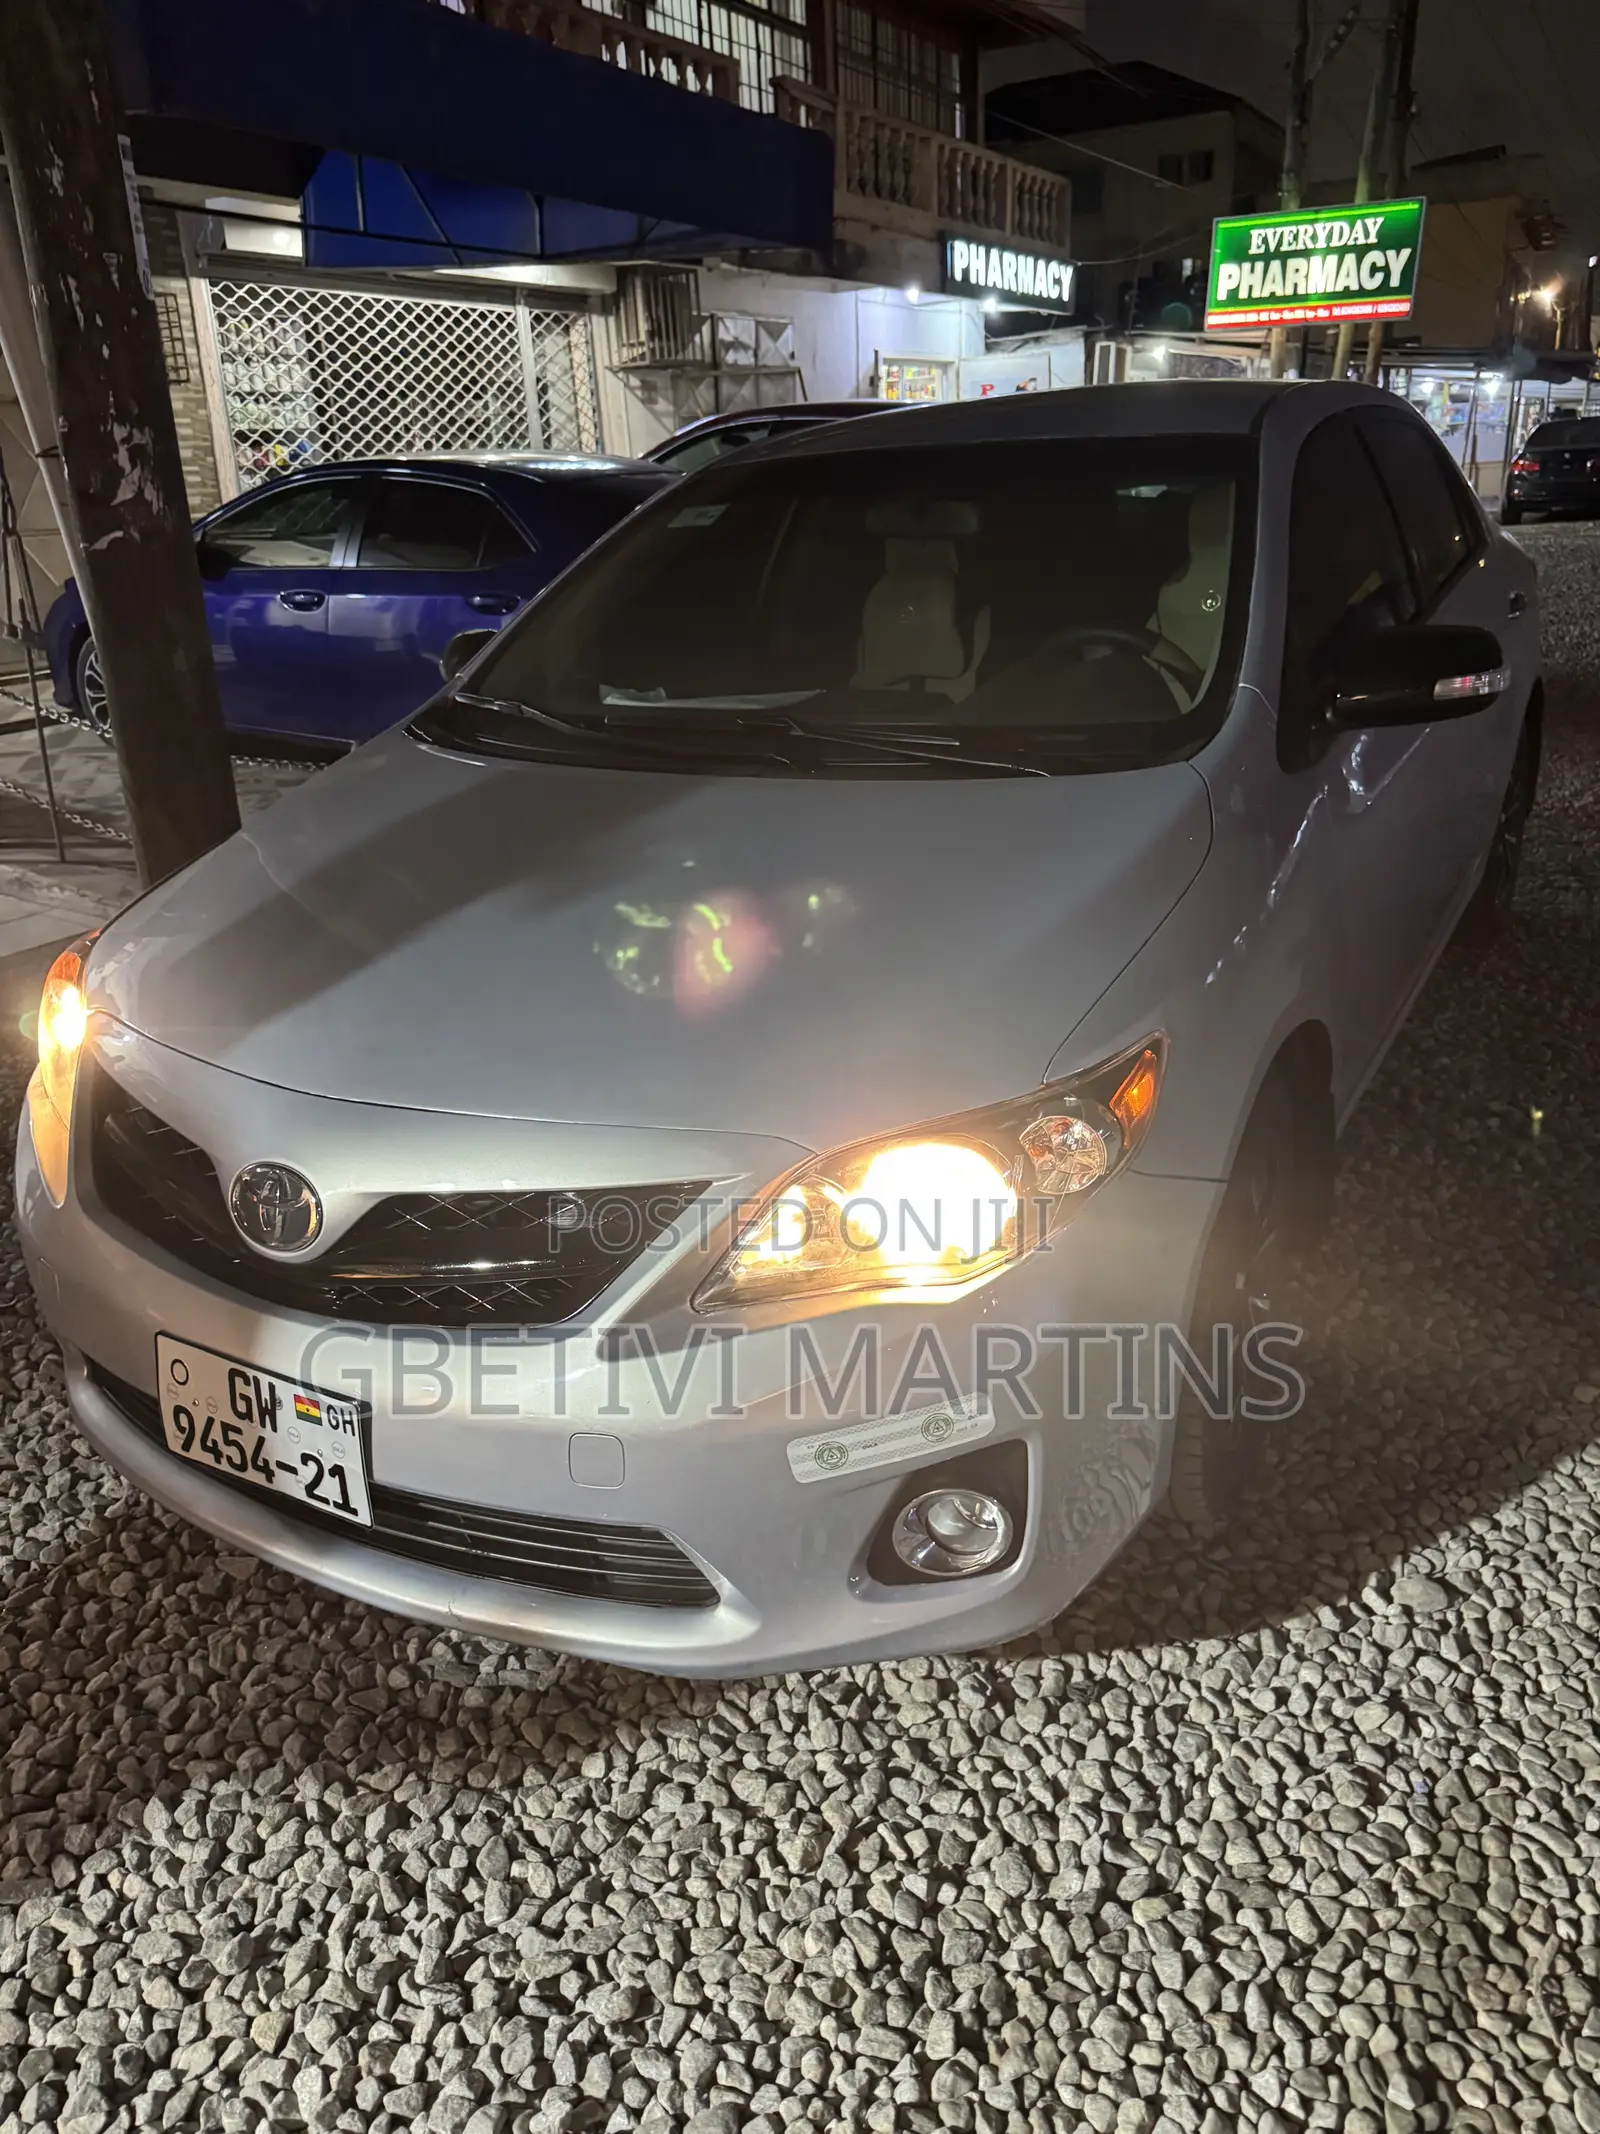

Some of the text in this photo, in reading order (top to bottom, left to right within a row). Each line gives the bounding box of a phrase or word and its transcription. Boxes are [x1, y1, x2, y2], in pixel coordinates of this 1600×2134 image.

[1248, 217, 1385, 254] EVERYDAY
[953, 239, 1074, 302] PHARMACY
[1216, 248, 1412, 301] PHARMACY
[227, 1367, 278, 1433] GW
[326, 1403, 356, 1437] GH
[172, 1404, 359, 1517] 9454-21
